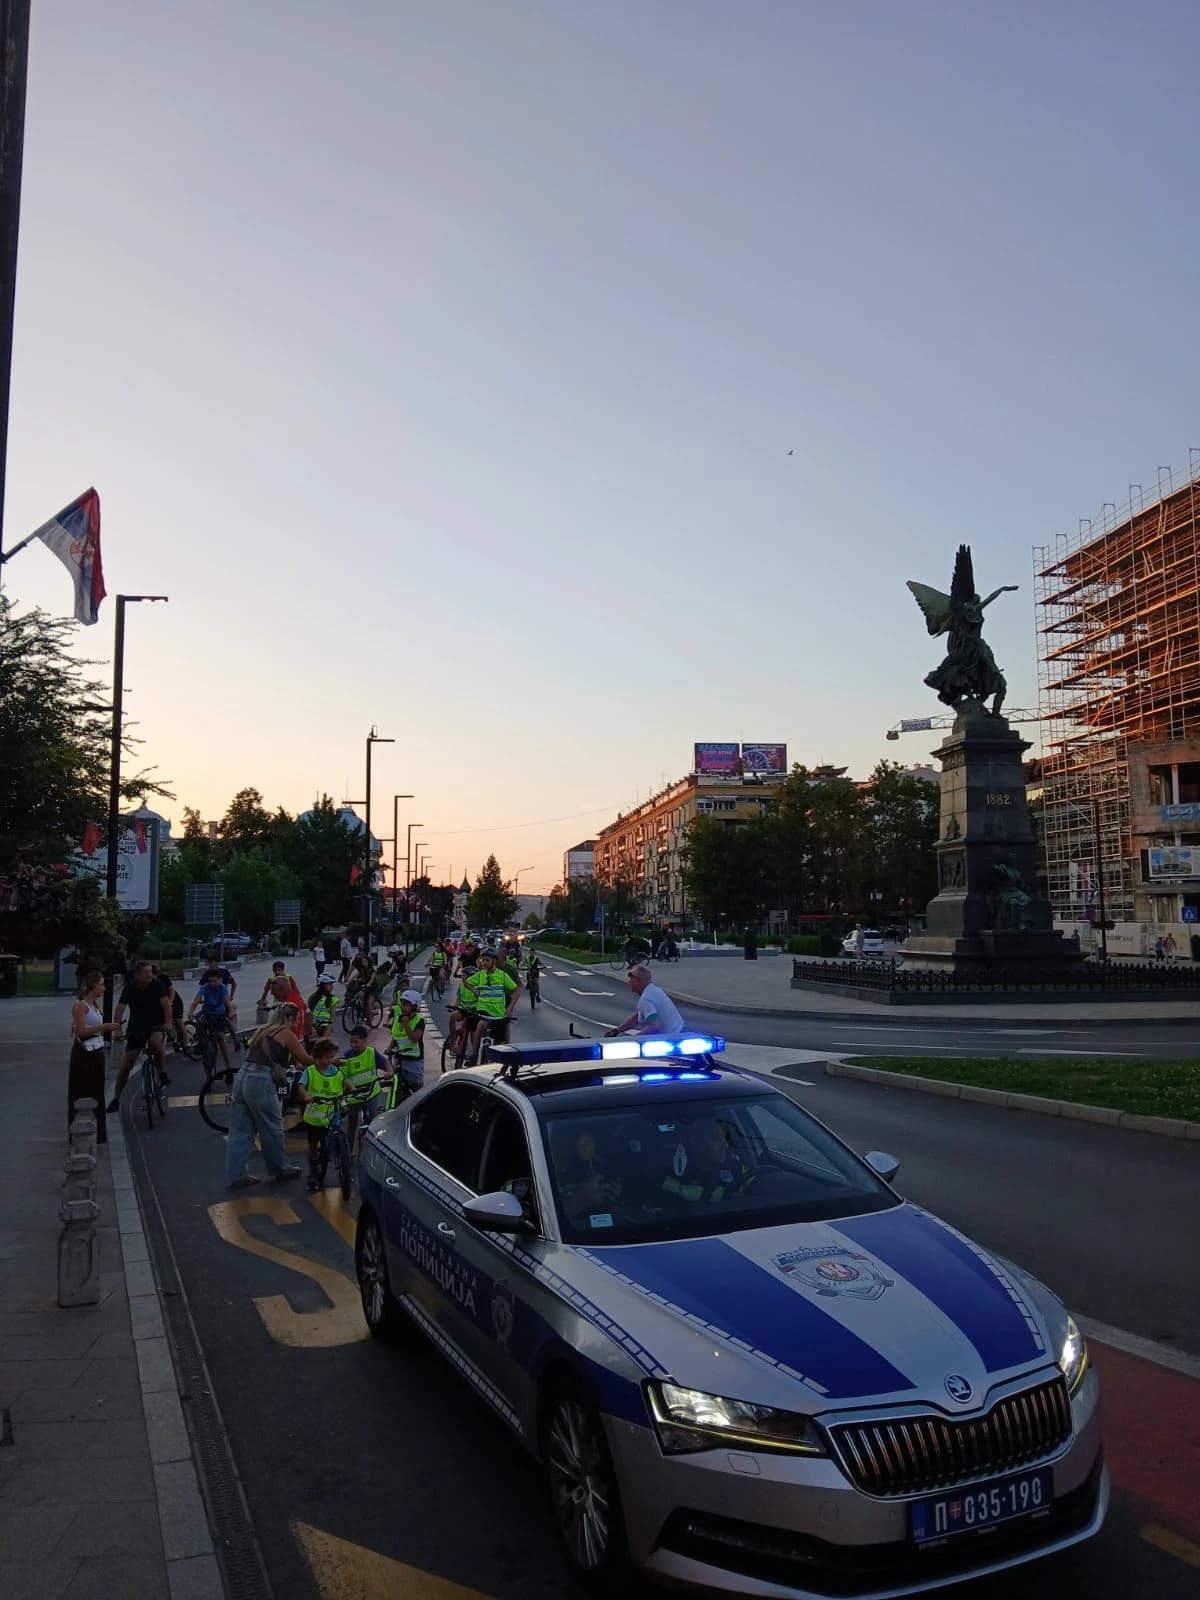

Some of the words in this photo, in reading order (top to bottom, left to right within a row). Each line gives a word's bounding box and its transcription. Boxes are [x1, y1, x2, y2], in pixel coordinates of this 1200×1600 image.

[986, 793, 1012, 805] 1882
[400, 1227, 477, 1318] ПОЛИЦИЈА
[935, 1501, 948, 1533] П
